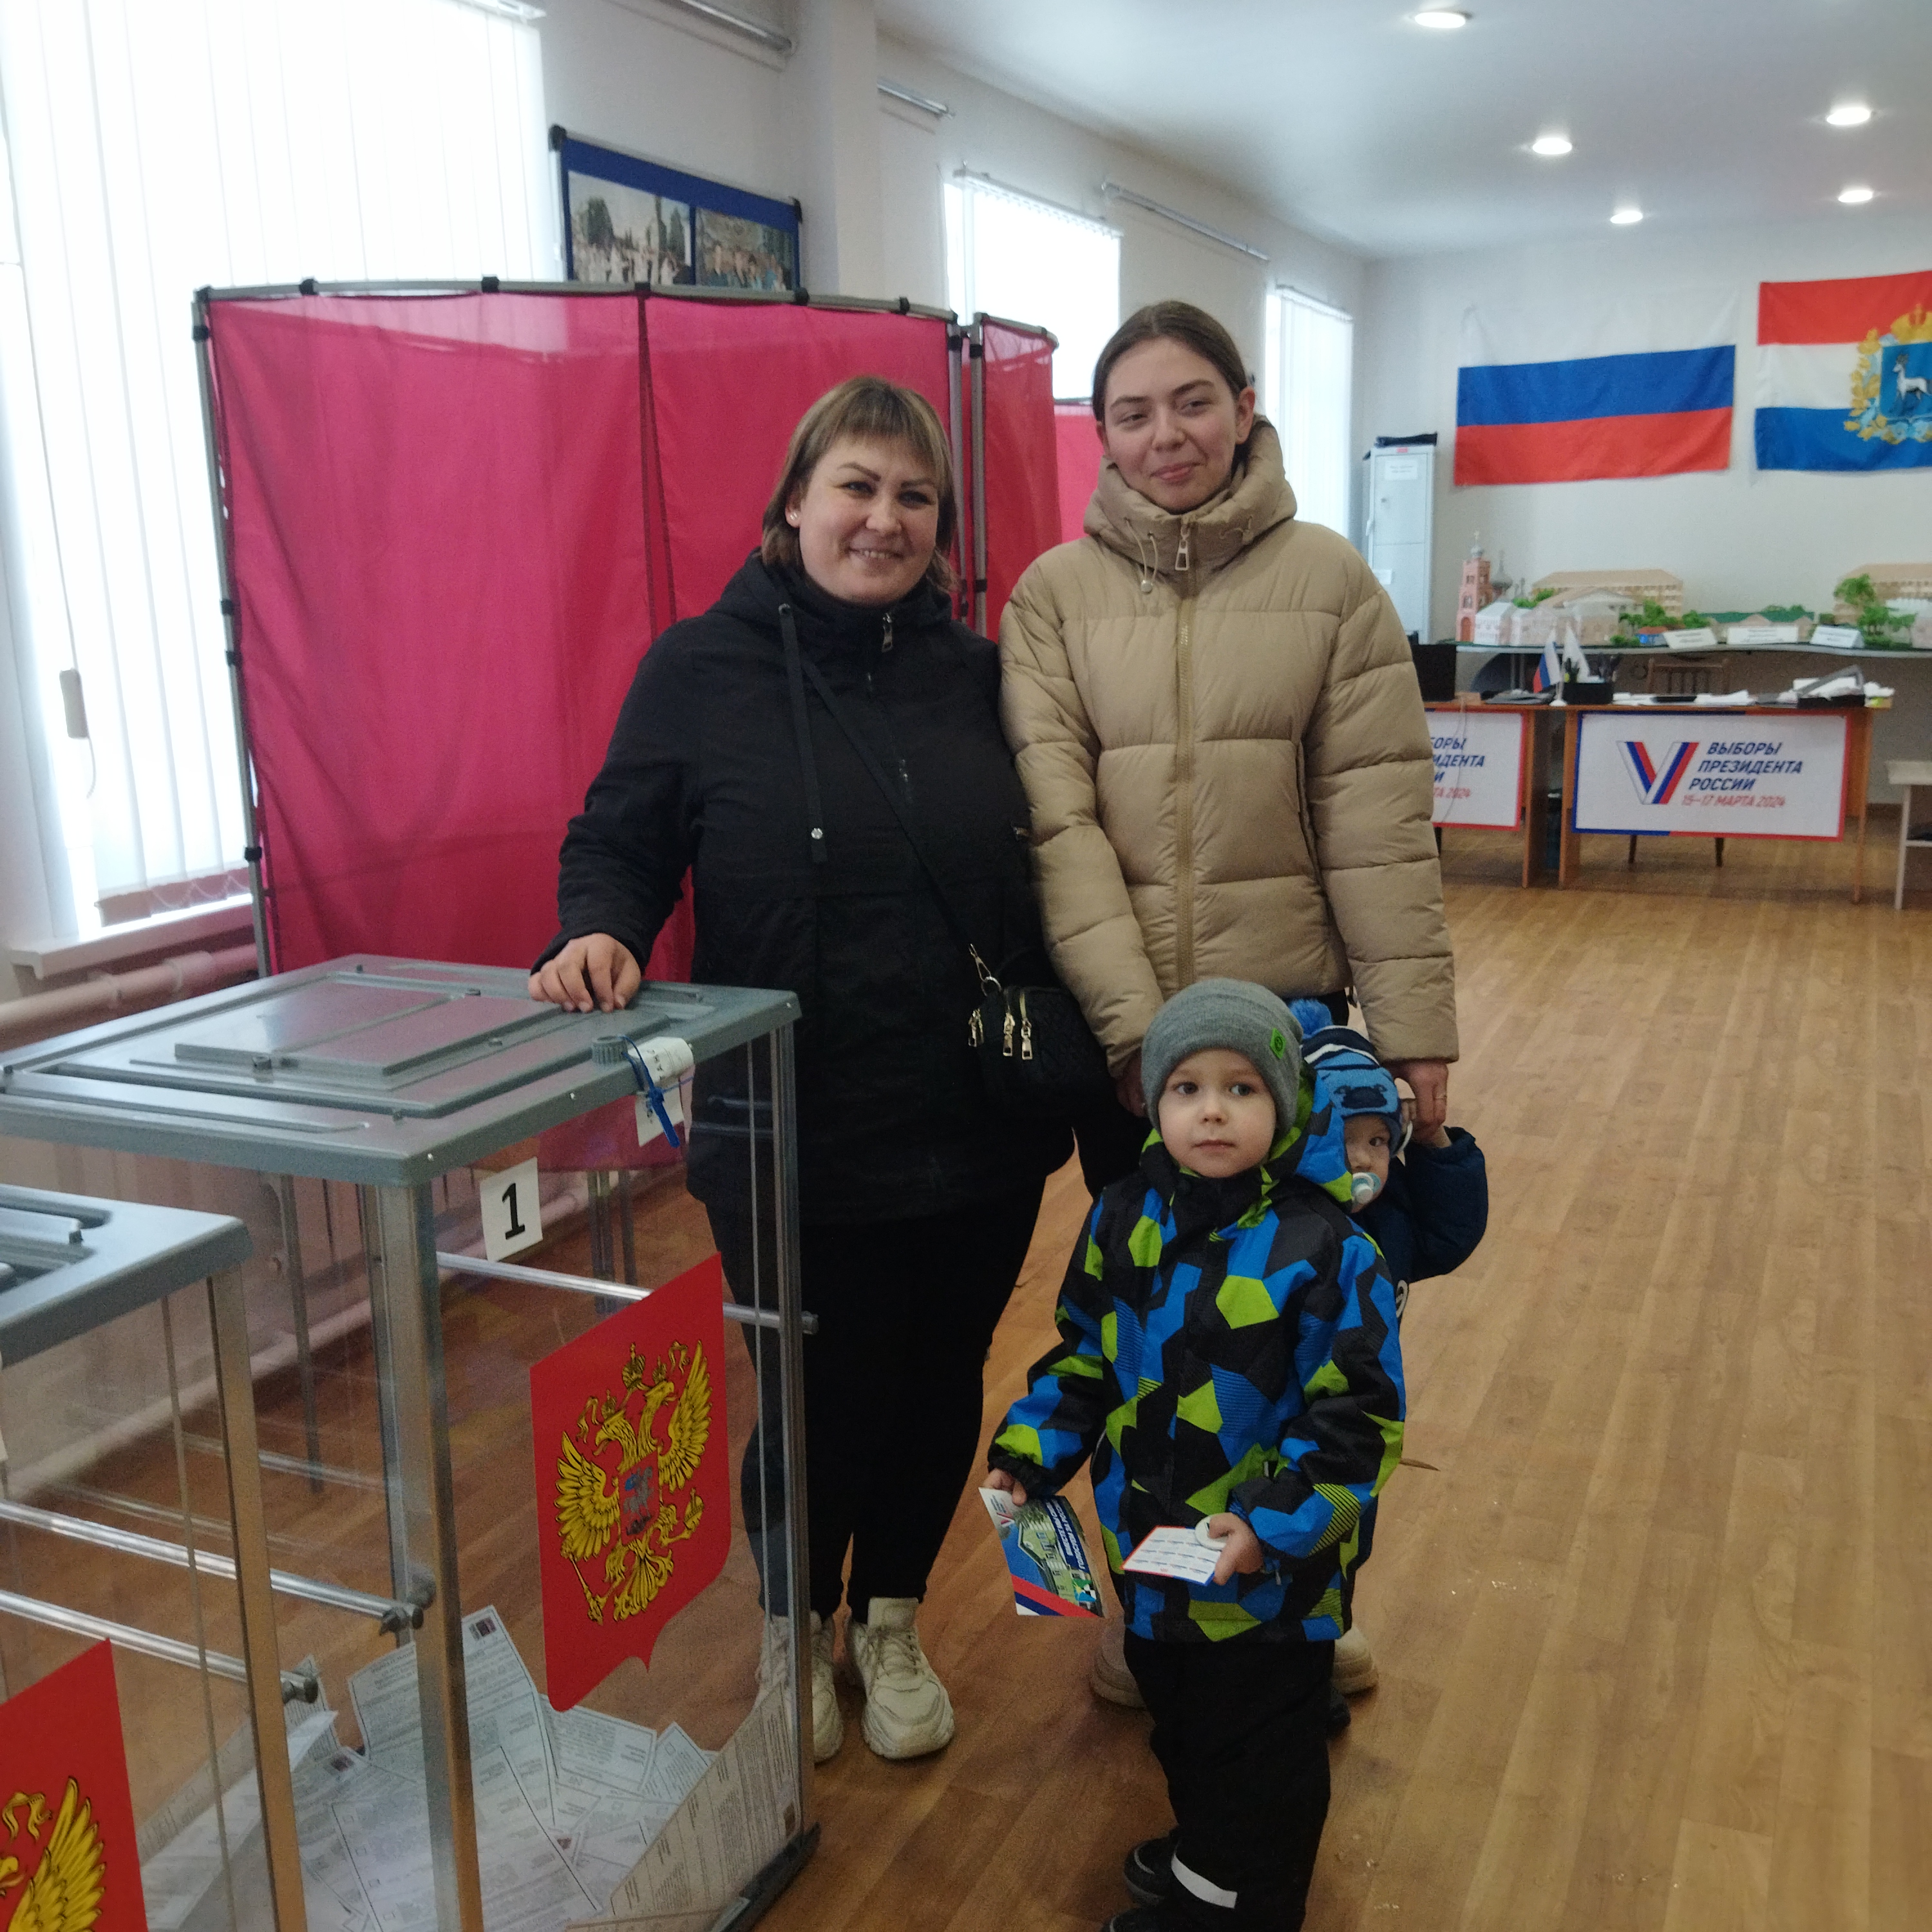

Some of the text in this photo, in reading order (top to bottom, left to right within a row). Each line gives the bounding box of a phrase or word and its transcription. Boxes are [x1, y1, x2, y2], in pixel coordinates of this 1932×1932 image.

[1430, 737, 1467, 750] ОРЫ
[1707, 742, 1783, 755] ВЫБОРЫ
[1432, 754, 1485, 768] ИДЕНТА
[1698, 760, 1803, 774] ПРЕЗИДЕНТА
[1689, 777, 1756, 791] РОССИИ
[1714, 795, 1755, 806] МАРТА
[1756, 795, 1786, 808] 2024
[502, 1183, 526, 1240] 1
